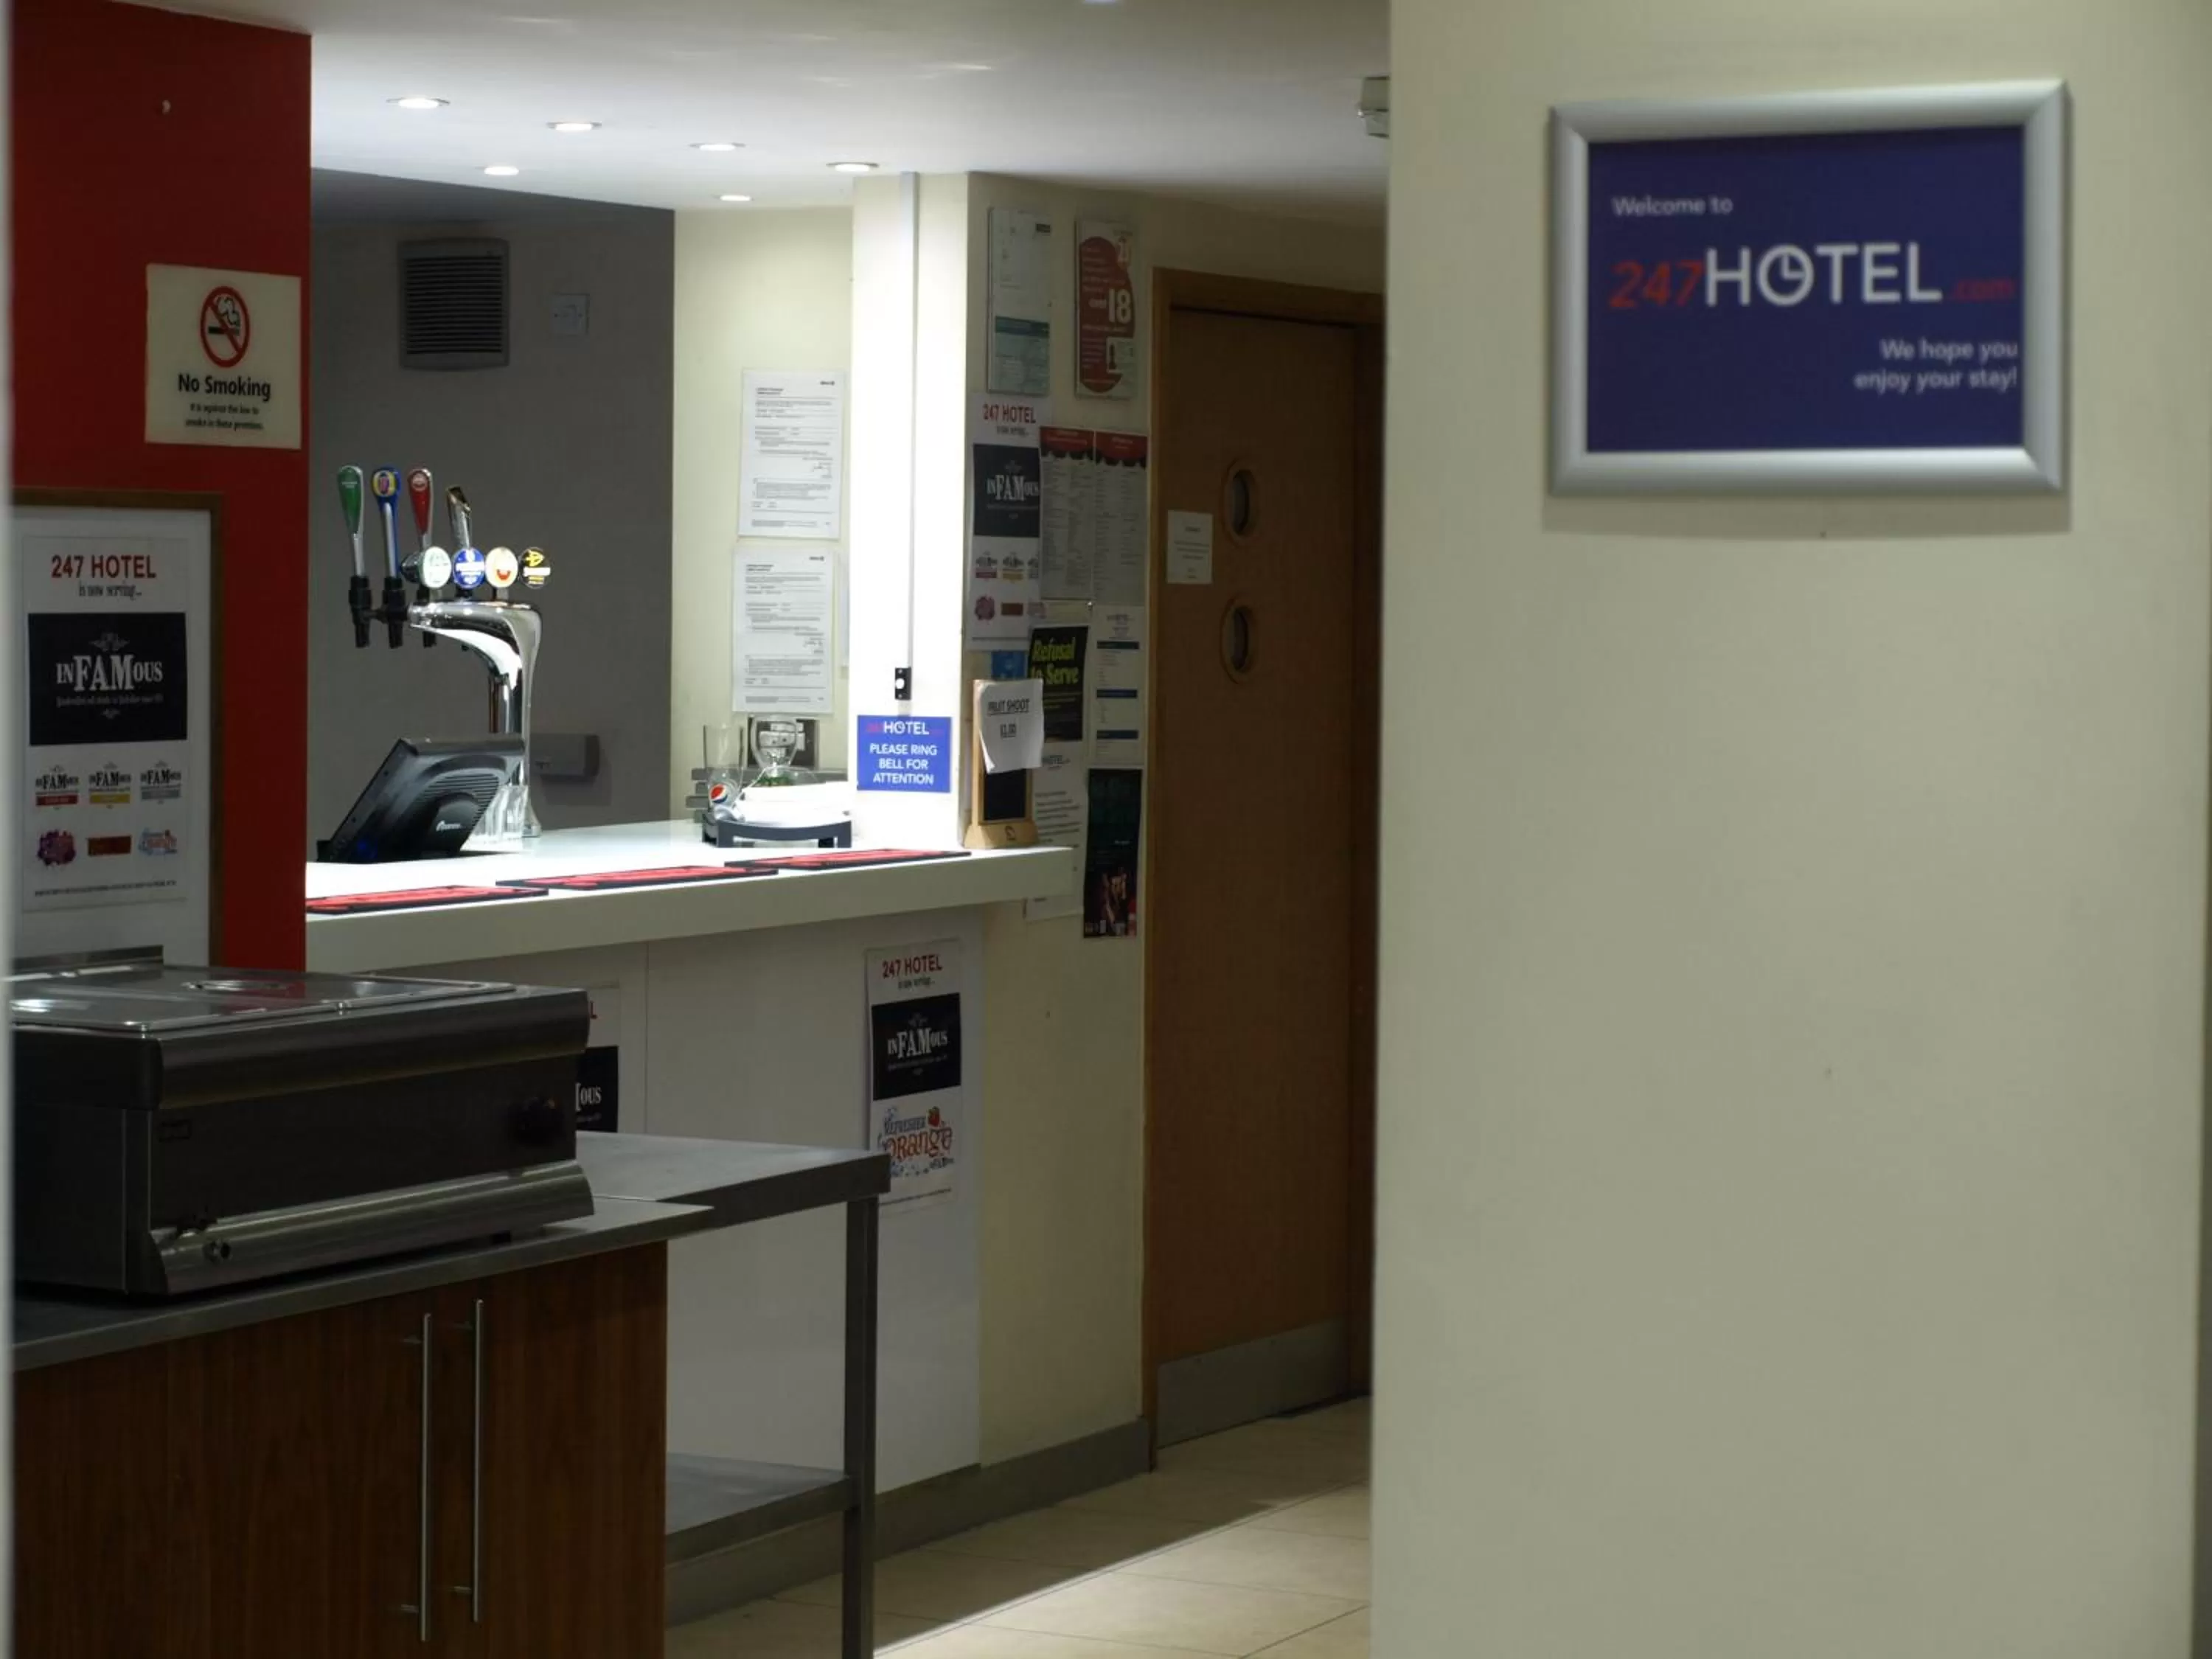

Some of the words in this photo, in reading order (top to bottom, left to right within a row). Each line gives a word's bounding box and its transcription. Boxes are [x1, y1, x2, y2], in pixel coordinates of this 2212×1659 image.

[1612, 196, 1705, 217] Welcome
[1710, 195, 1733, 215] to
[1880, 340, 1914, 360] We
[1920, 338, 1973, 364] hope
[1979, 342, 2019, 364] you
[178, 373, 200, 392] No
[205, 375, 271, 403] Smoking
[1854, 369, 1911, 394] enjoy
[1916, 370, 1962, 393] your
[1969, 366, 2018, 392] stay!
[1002, 404, 1037, 424] HOTEL
[51, 554, 85, 579] 247
[91, 554, 157, 579] HOTEL
[1032, 636, 1077, 662] Refusal
[869, 742, 909, 755] PLEASE
[911, 744, 938, 756] RING
[879, 758, 904, 769] BELL
[906, 759, 929, 770] FOR
[873, 773, 935, 786] ATTENTION
[883, 960, 902, 978] 247
[905, 954, 944, 976] HOTEL
